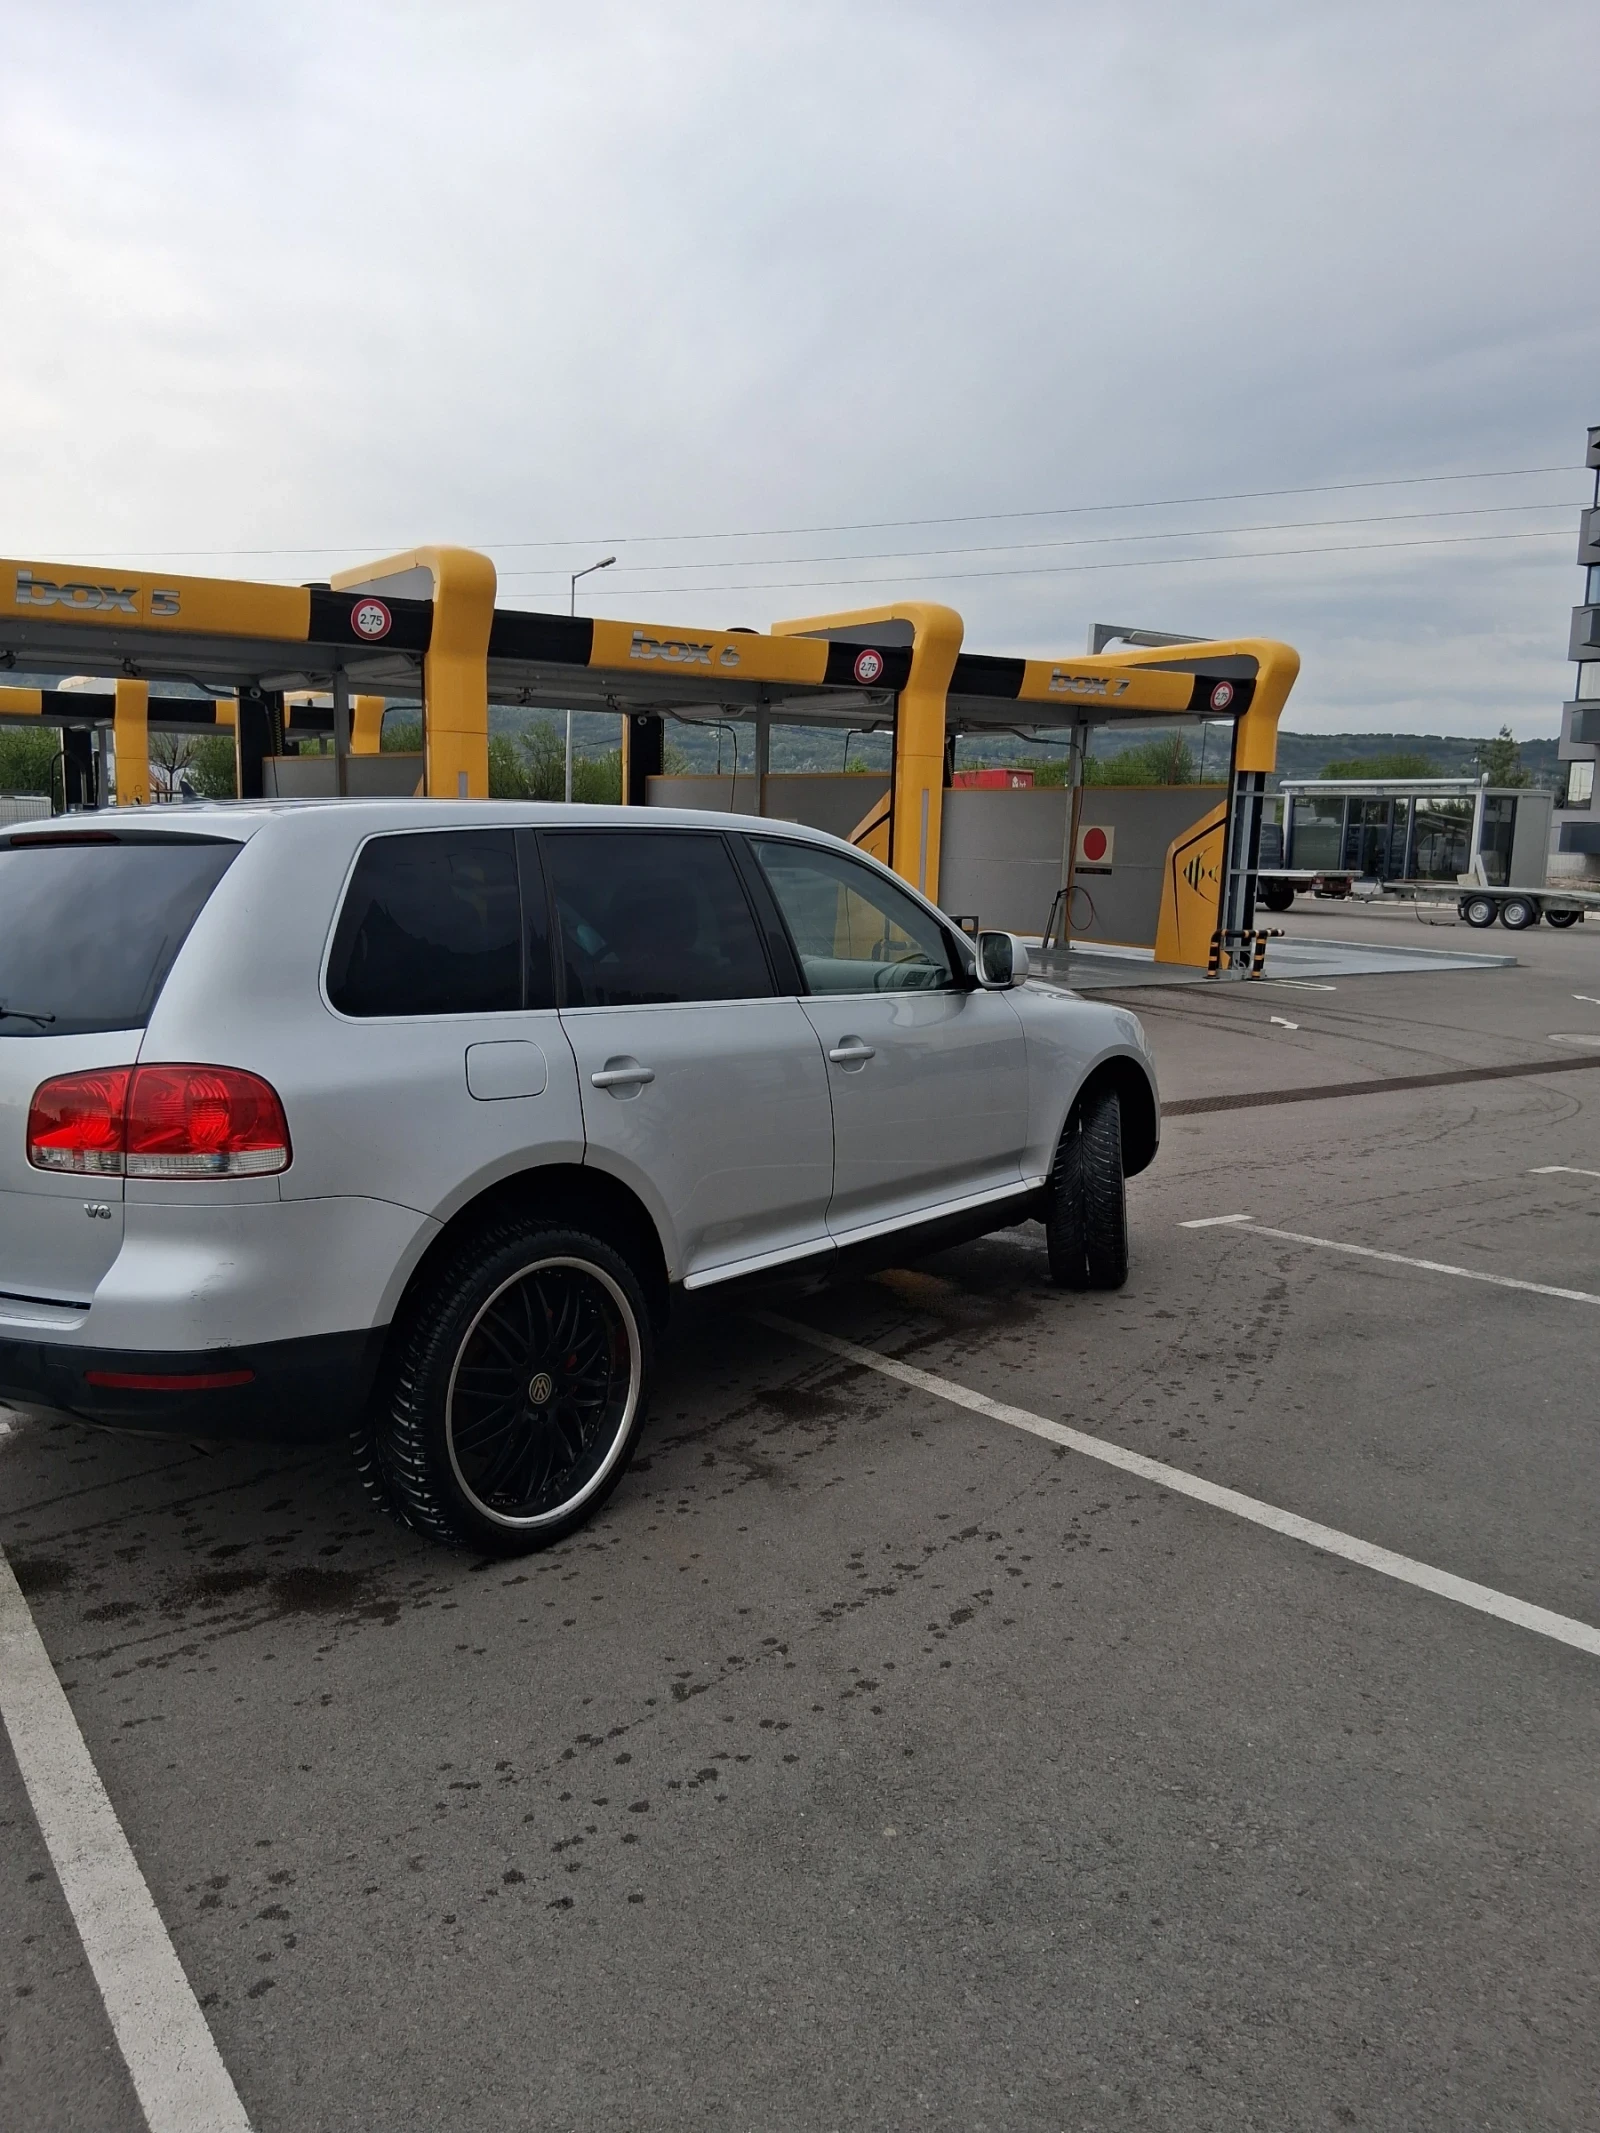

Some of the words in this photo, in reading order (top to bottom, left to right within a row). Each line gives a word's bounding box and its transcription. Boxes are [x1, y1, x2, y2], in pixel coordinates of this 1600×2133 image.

[16, 570, 140, 613] box
[151, 589, 180, 616] 5
[360, 613, 383, 626] 2.75
[630, 630, 714, 665] box
[720, 645, 740, 667] 6
[860, 661, 877, 672] 2.75
[1048, 667, 1111, 696] box
[1112, 678, 1131, 696] 7
[83, 1203, 112, 1219] V6
